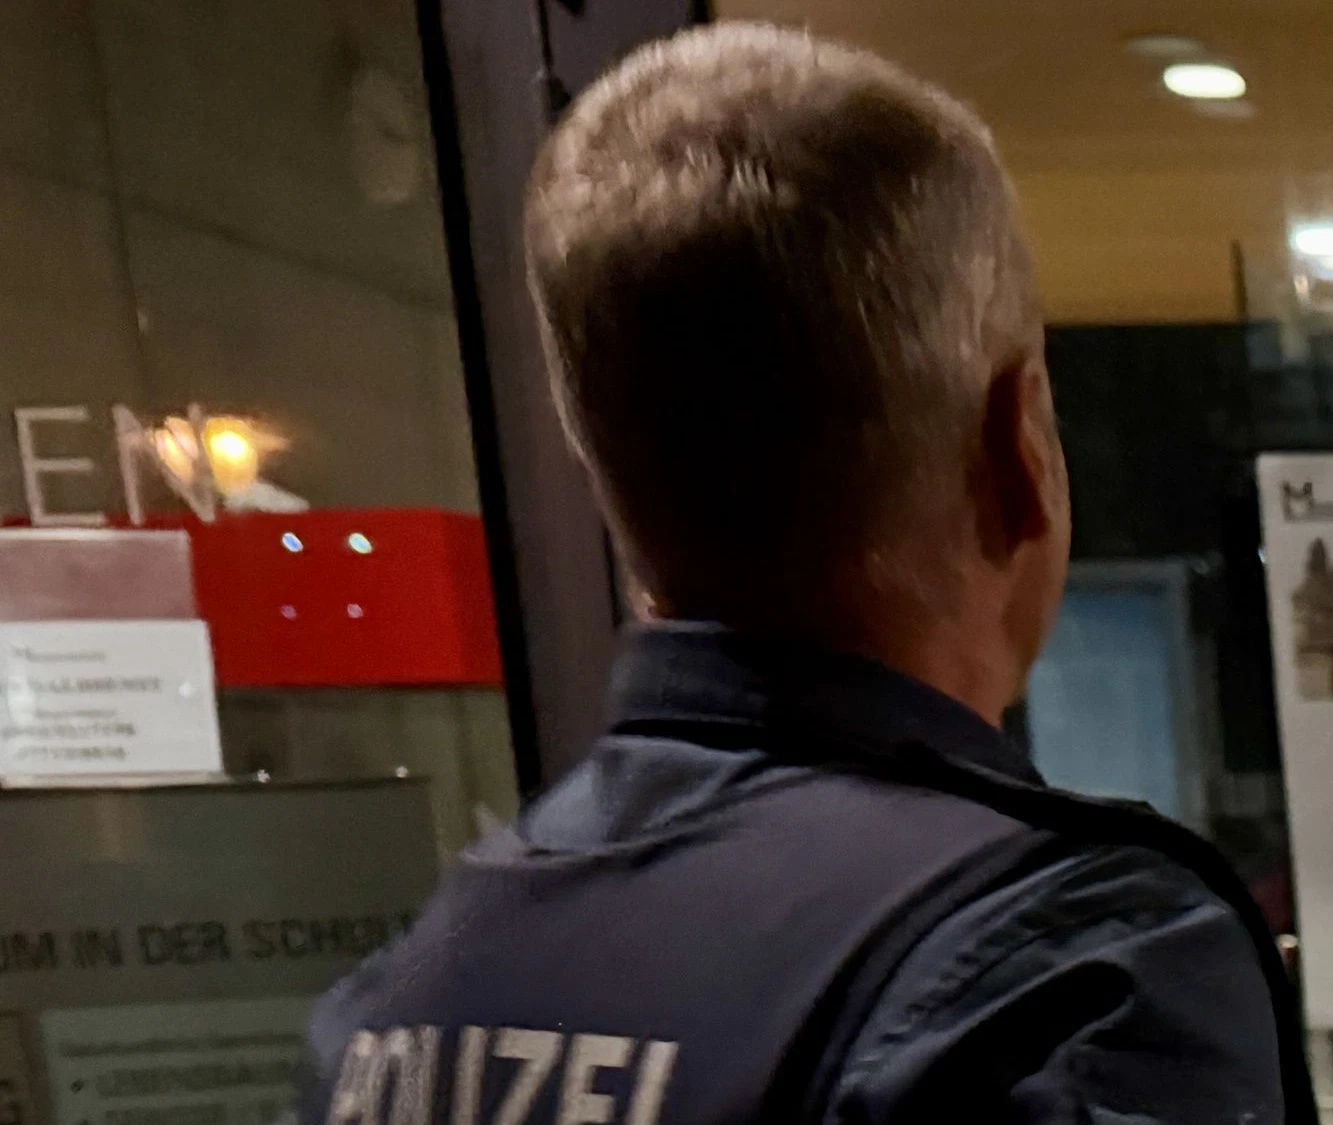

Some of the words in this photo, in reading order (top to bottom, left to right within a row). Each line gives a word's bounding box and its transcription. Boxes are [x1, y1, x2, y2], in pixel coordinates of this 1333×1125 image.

[0, 930, 58, 972] M
[72, 927, 123, 970] IN
[137, 920, 231, 966] DER
